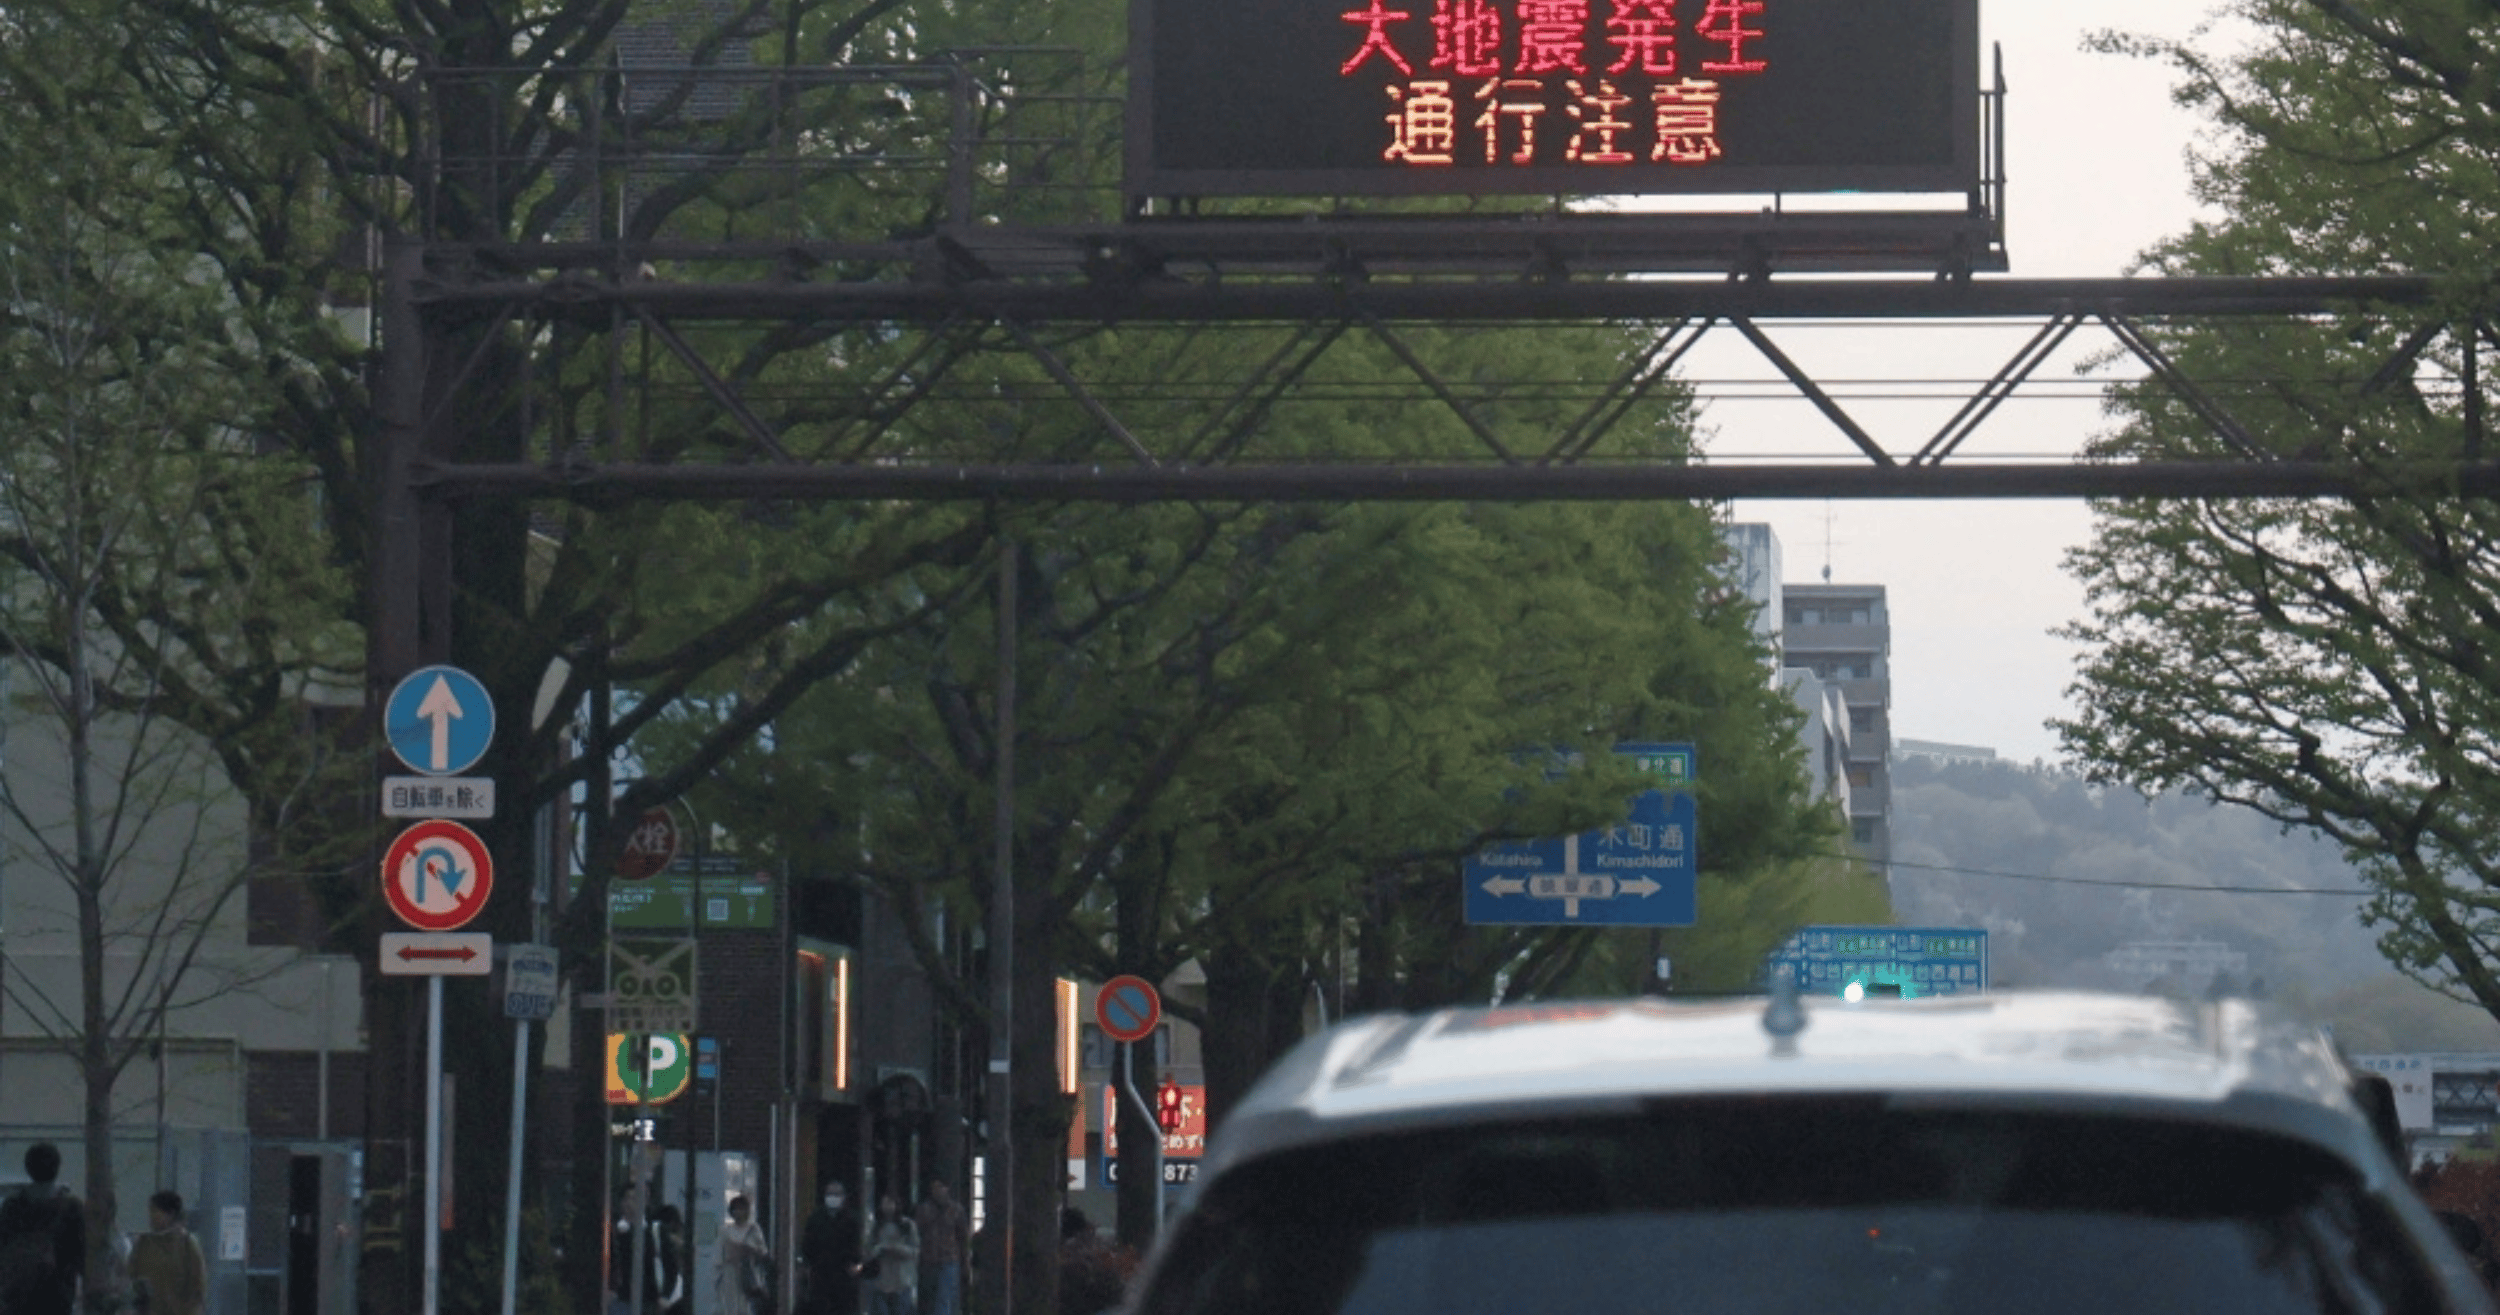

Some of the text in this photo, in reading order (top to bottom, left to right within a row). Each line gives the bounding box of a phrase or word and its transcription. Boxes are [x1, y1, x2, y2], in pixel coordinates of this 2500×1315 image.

[1339, 0, 1768, 76] 大地震発生
[1383, 77, 1723, 164] 通行注意
[392, 785, 485, 809] 自転車を除く
[1597, 823, 1684, 850] 木町通
[1597, 853, 1684, 868] Kimachidori
[646, 1036, 679, 1088] P
